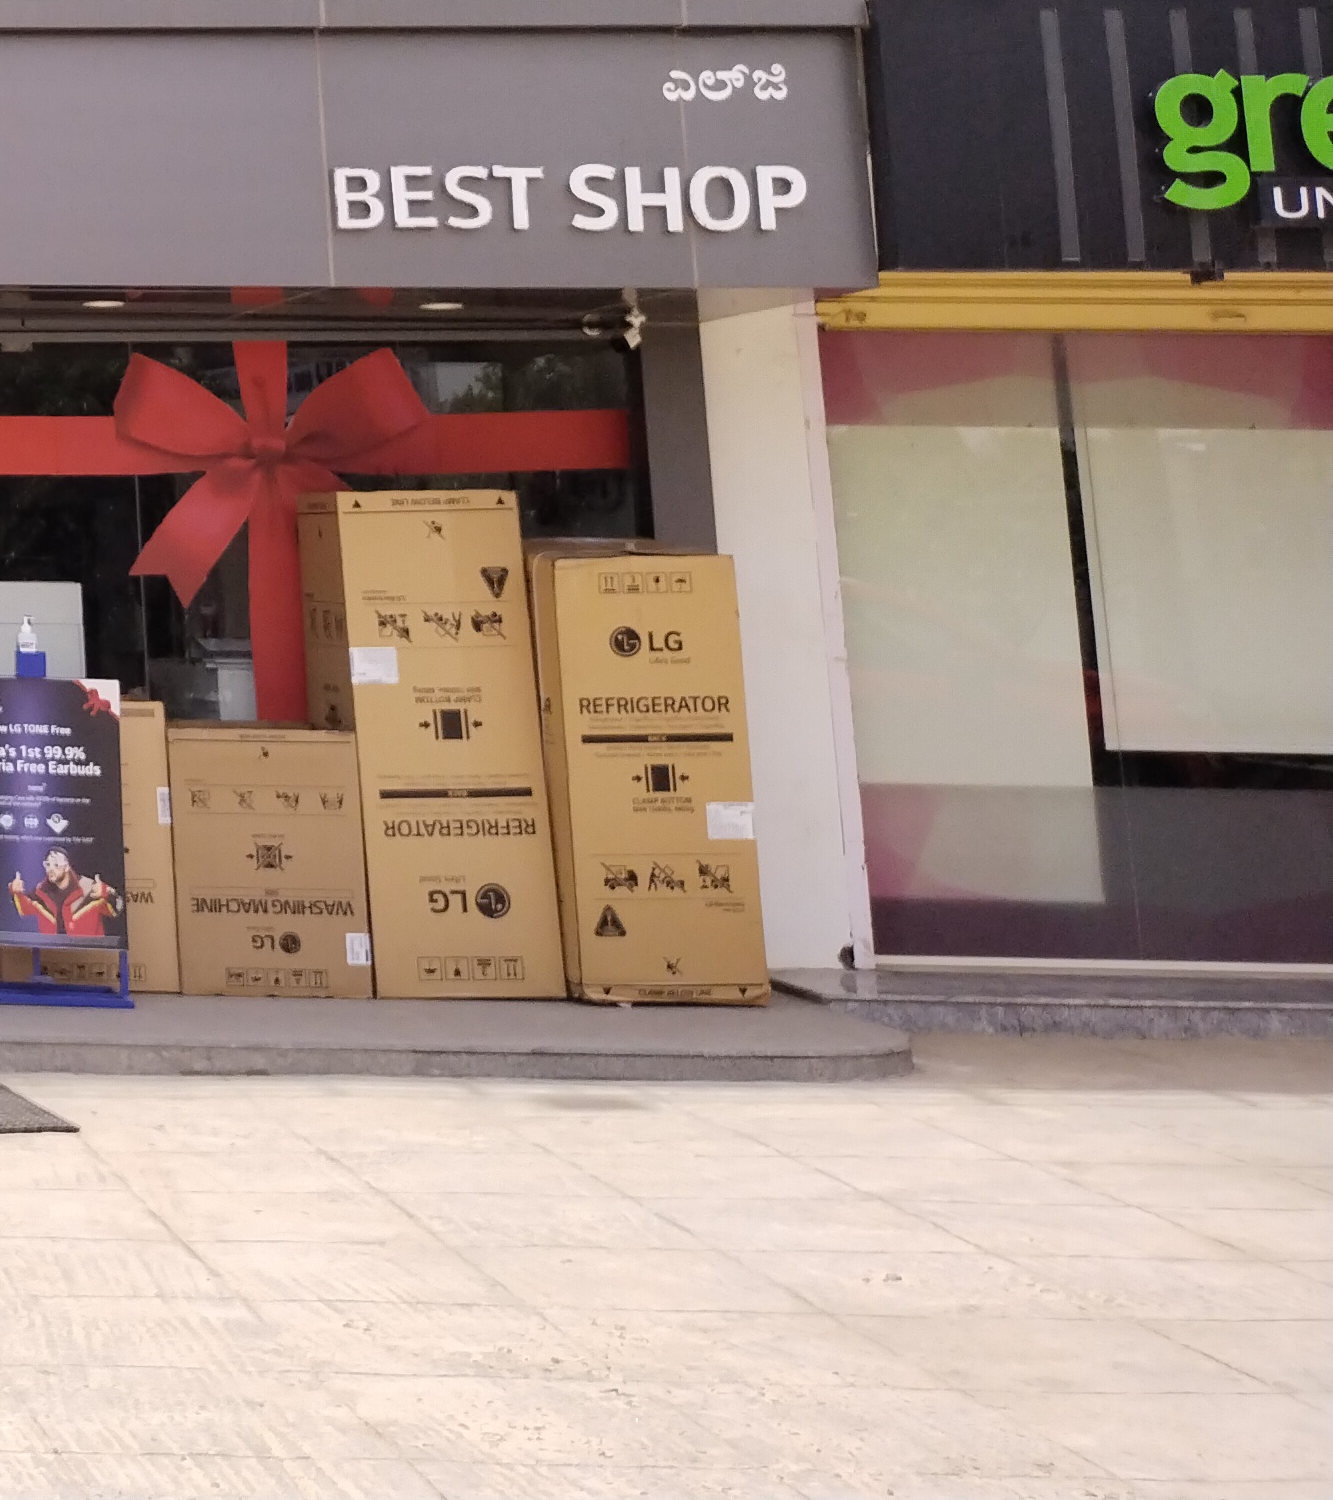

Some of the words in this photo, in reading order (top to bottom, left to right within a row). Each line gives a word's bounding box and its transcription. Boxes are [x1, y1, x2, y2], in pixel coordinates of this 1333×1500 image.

[332, 164, 546, 231] BEST
[568, 163, 808, 233] SHOP
[647, 630, 683, 652] LG
[579, 695, 731, 715] REFRIGERATOR
[9, 723, 22, 734] LG
[23, 723, 50, 735] TONE
[51, 724, 72, 736] Free
[19, 745, 42, 759] 1st
[44, 746, 87, 761] 99.9%
[17, 760, 46, 774] Free
[48, 762, 102, 777] Earbuds
[382, 818, 537, 838] REFRIGERATOR
[190, 897, 269, 916] MACHINE
[271, 898, 355, 917] WASHING
[427, 889, 468, 914] LG
[250, 934, 275, 951] LG
